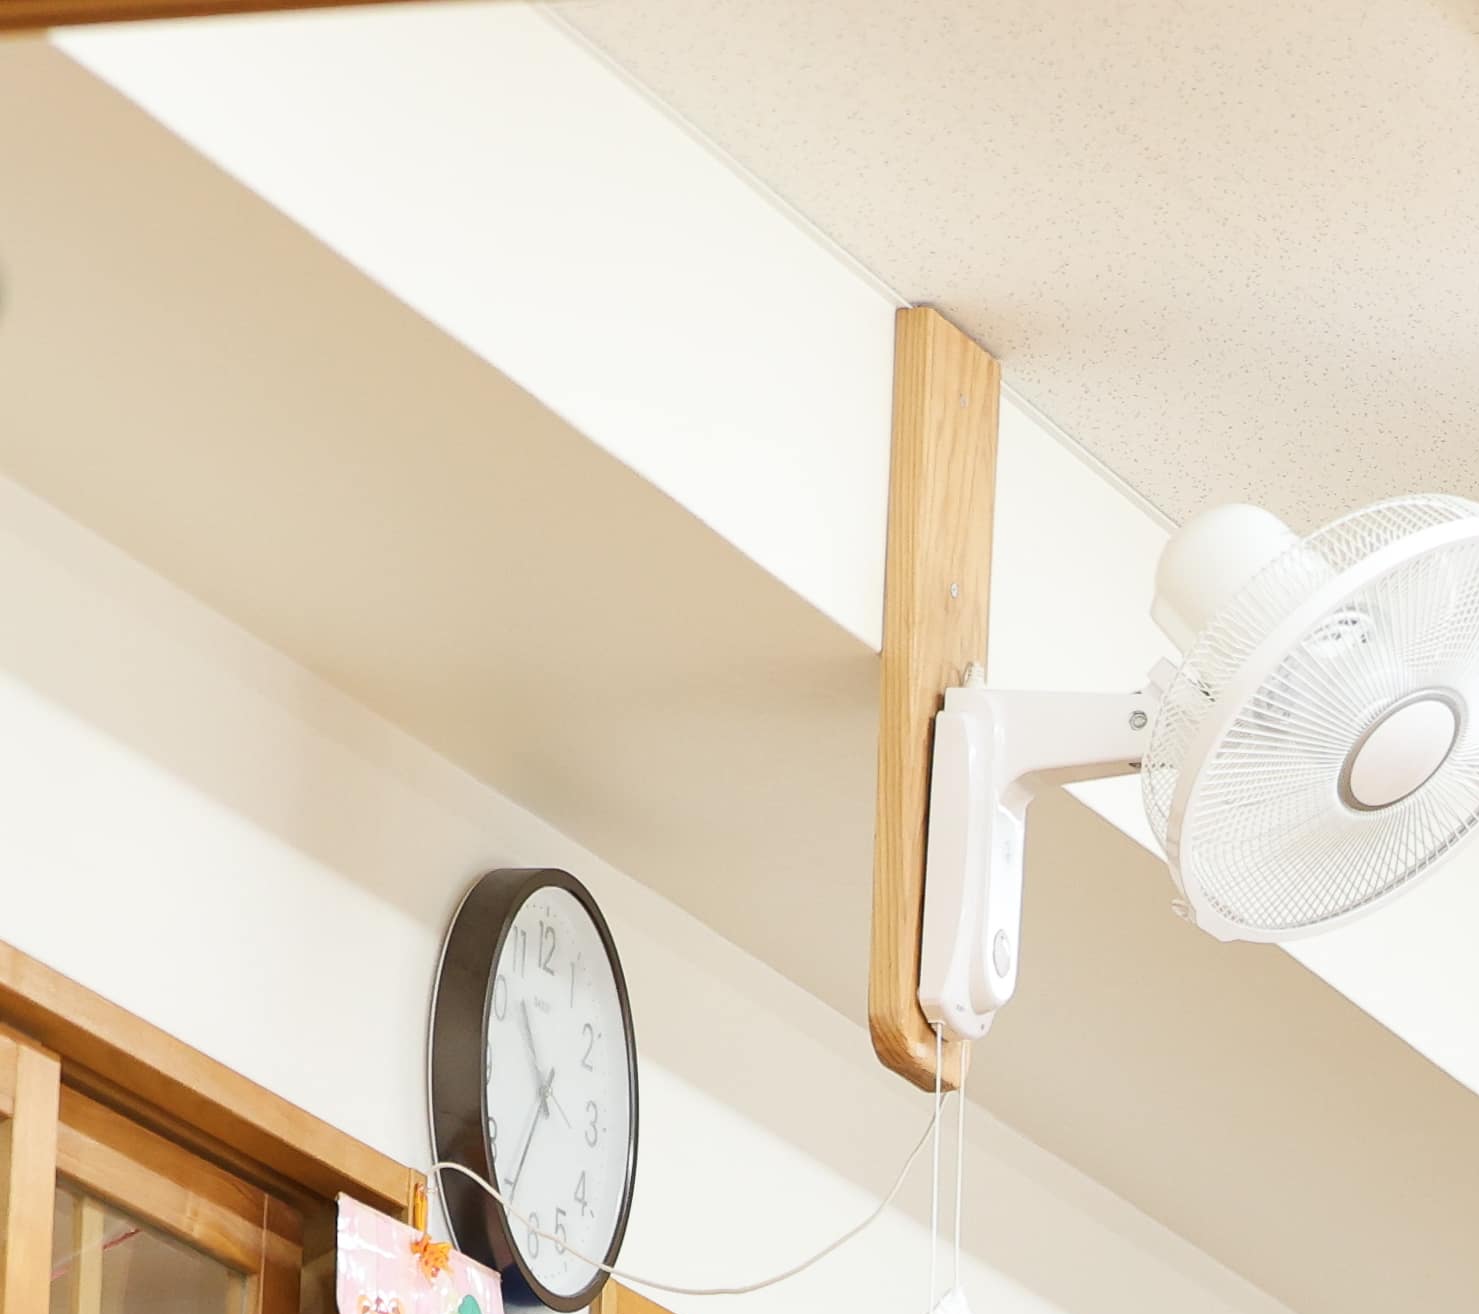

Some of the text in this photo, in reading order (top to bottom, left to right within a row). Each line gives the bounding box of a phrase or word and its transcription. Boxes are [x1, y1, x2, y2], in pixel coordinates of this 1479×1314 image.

[513, 925, 528, 979] 11
[538, 919, 557, 977] 12
[581, 1022, 595, 1072] 2
[584, 1099, 599, 1149] 3
[573, 1169, 589, 1217] 4
[554, 1206, 569, 1255] 5
